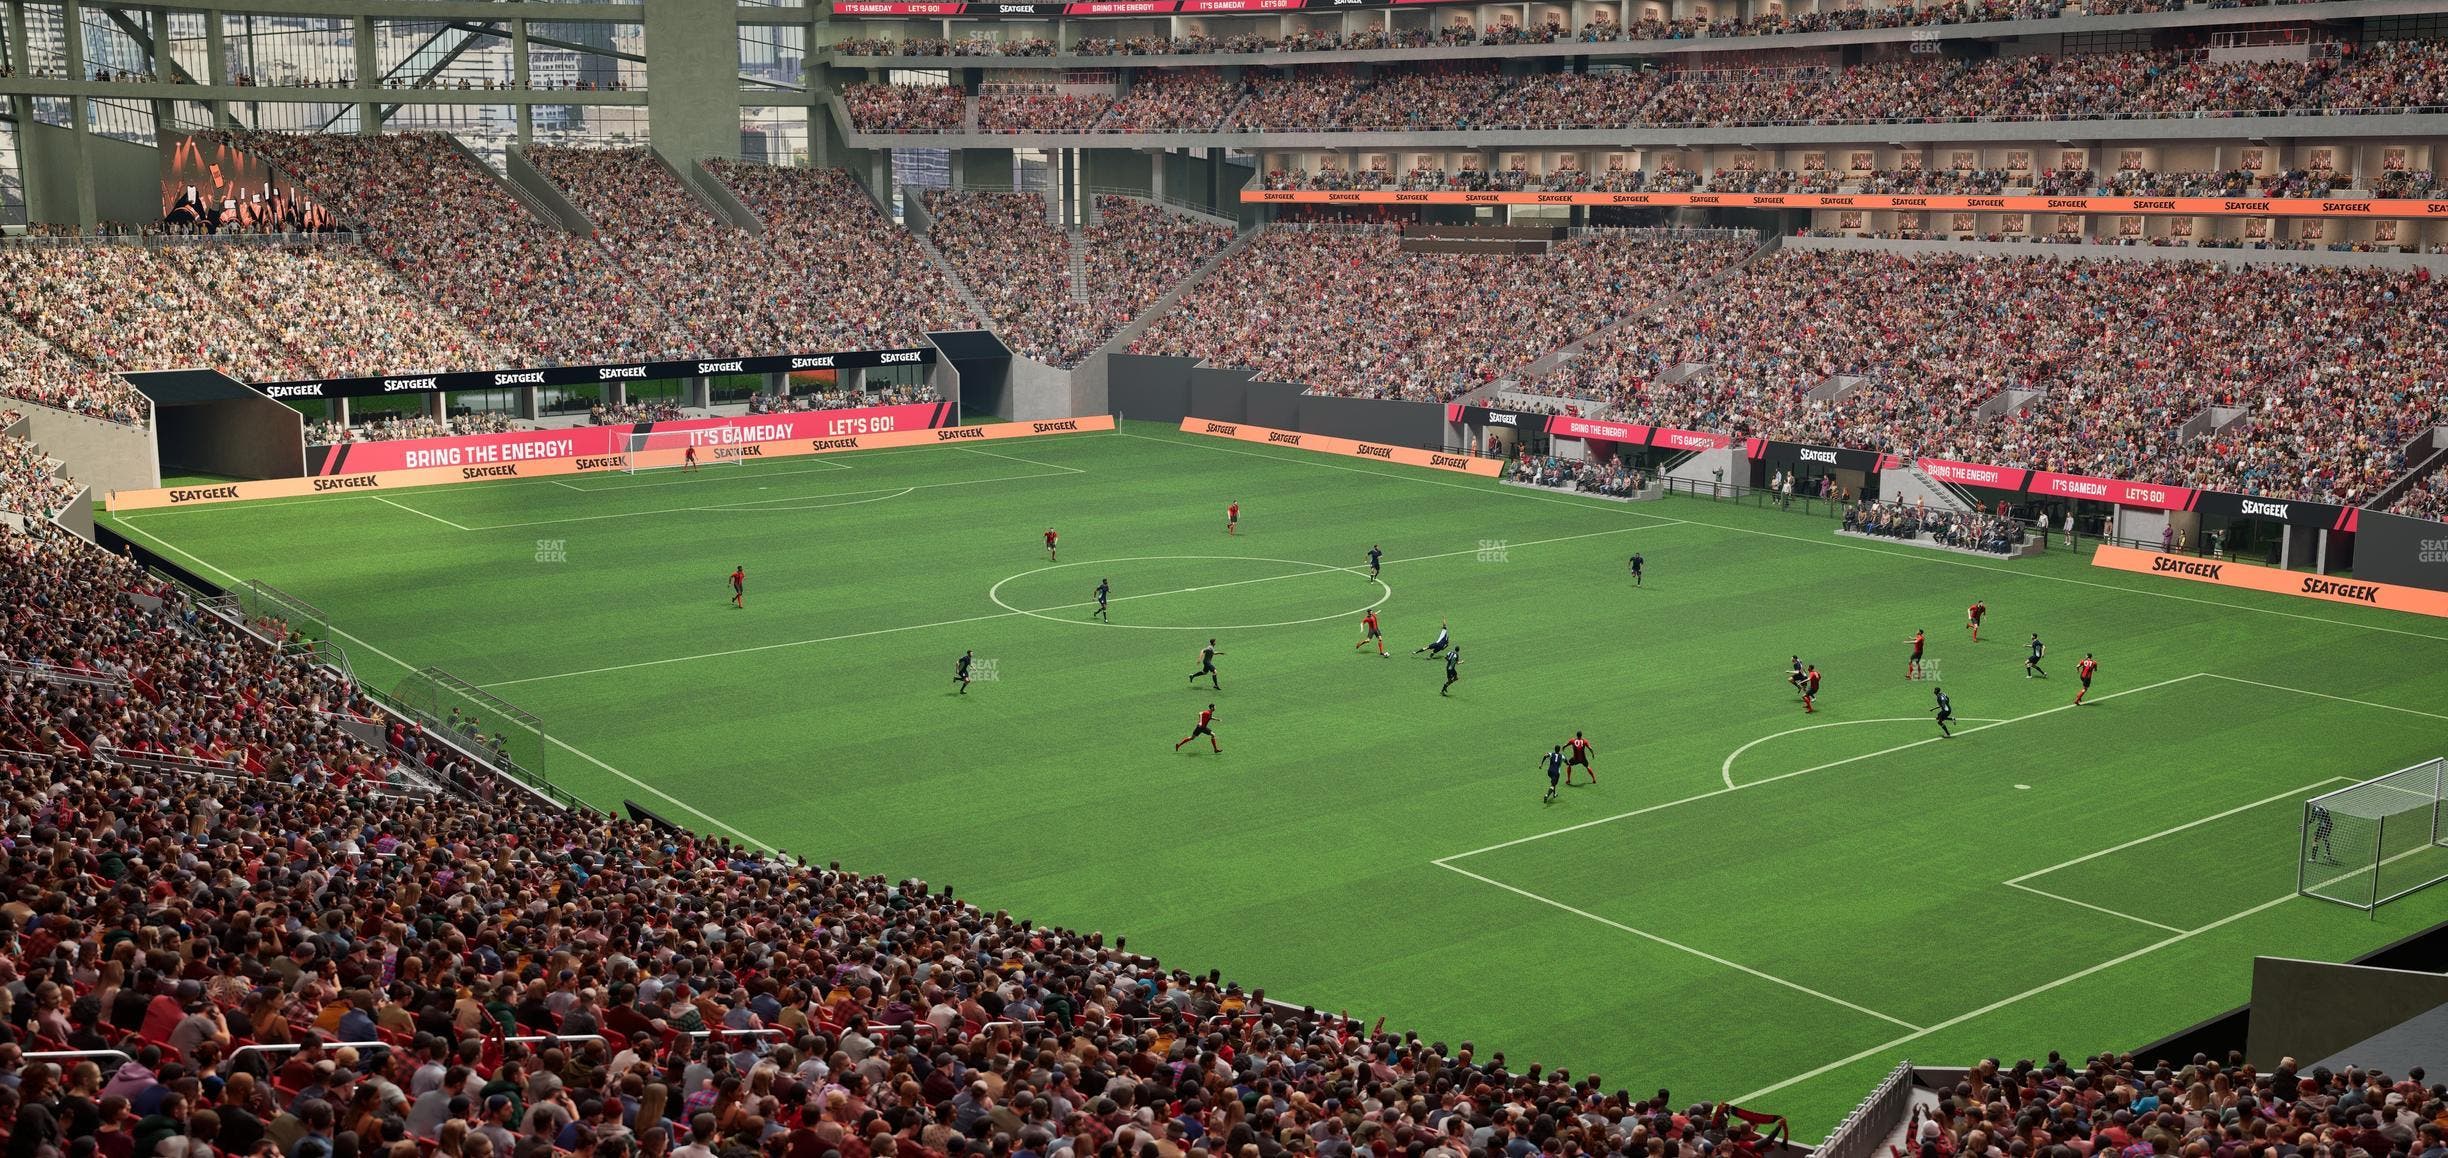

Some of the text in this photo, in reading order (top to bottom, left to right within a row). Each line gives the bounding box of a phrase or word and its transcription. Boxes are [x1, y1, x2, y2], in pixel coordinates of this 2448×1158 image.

[1000, 5, 1034, 13] SEATGEEK
[1092, 4, 1113, 12] BRING
[1466, 194, 1499, 202] SEATGEEK
[1538, 194, 1572, 202] SEATGEEK
[1613, 195, 1649, 203] SEATGEEK
[1753, 196, 1784, 204] SEATGEEK
[1820, 197, 1853, 205] SEATGEEK
[1892, 198, 1926, 206] SEATGEEK
[1968, 199, 2004, 207] SEATGEEK
[2048, 200, 2087, 208] SEATGEEK
[2133, 201, 2175, 210] SEATGEEK
[2225, 201, 2270, 211] SEATGEEK
[2323, 202, 2370, 212] SEATGEEK
[792, 356, 834, 368] SEATGEEK
[880, 352, 921, 364] SEATGEEK
[600, 366, 647, 379] SEATGEEK
[698, 360, 743, 374] SEATGEEK
[384, 377, 437, 392] SEATGEEK
[495, 372, 545, 385] SEATGEEK
[267, 383, 323, 398] SEATGEEK
[1489, 411, 1517, 425] SEATGEEK
[690, 416, 894, 446] IT'S GAMEDAY LET'S GO!
[1033, 420, 1078, 433] SEATGEEK
[1206, 422, 1237, 436] SEATGEEK
[1570, 423, 1628, 438] BRING THE ENERGY!
[938, 427, 984, 441] SEATGEEK
[1268, 431, 1301, 446] SEATGEEK
[1671, 434, 1682, 444] IT'S
[812, 437, 858, 451] SEATGEEK
[406, 440, 573, 468] BRING THE ENERGY!
[1356, 444, 1392, 459] SEATGEEK
[1800, 448, 1837, 464] SEATGEEK
[576, 455, 627, 470] SEATGEEK
[1430, 454, 1469, 470] SEATGEEK
[463, 464, 517, 479] SEATGEEK
[1952, 467, 1966, 479] THE
[1967, 470, 1998, 483] ENERGY!
[313, 475, 379, 491] SEATGEEK
[170, 486, 239, 503] SEATGEEK
[2052, 479, 2165, 503] IT'S GAMEDAY LET'S GO!
[2242, 499, 2289, 519] SEATGEEK
[2152, 556, 2223, 580] SEATGEEK
[2302, 577, 2380, 603] SEATGEEK
